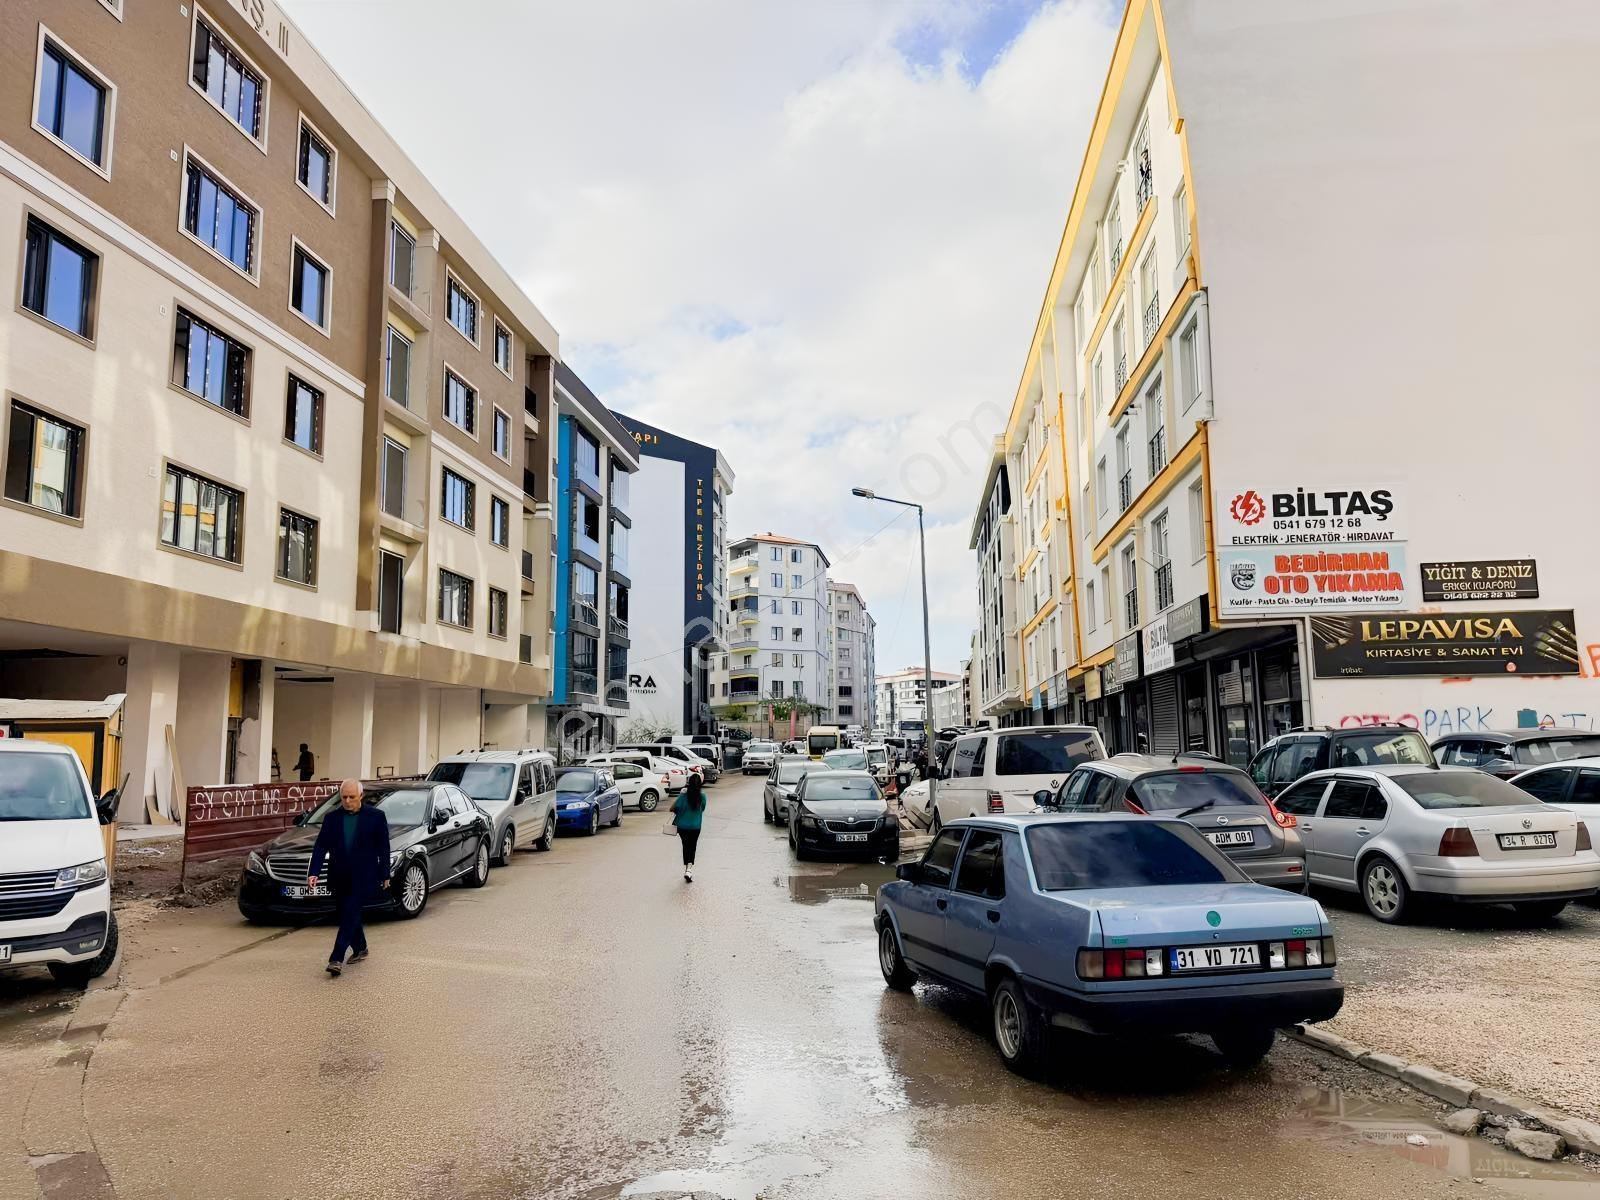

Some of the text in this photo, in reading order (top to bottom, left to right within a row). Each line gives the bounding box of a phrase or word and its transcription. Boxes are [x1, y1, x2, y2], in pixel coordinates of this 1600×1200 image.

[1272, 487, 1394, 521] BİLTAŞ
[1273, 518, 1362, 530] 0541 679 12 68
[1232, 531, 1395, 545] ELEKTRİK JENERATÖR HIRDAVAT
[1424, 561, 1533, 580] YİĞİT & DENİZ
[1264, 572, 1404, 595] OTO YIKAMA
[1442, 582, 1471, 591] ERKEK
[1351, 595, 1374, 603] Motor
[1360, 618, 1523, 642] LEPAVISA
[1366, 646, 1523, 658] KIRTASİYE & SANAT EVİ
[1424, 706, 1492, 737] PARK
[1215, 833, 1232, 843] ADM
[1505, 836, 1517, 846] 34
[1520, 835, 1526, 845] R
[1178, 945, 1255, 968] 31 VD 721
